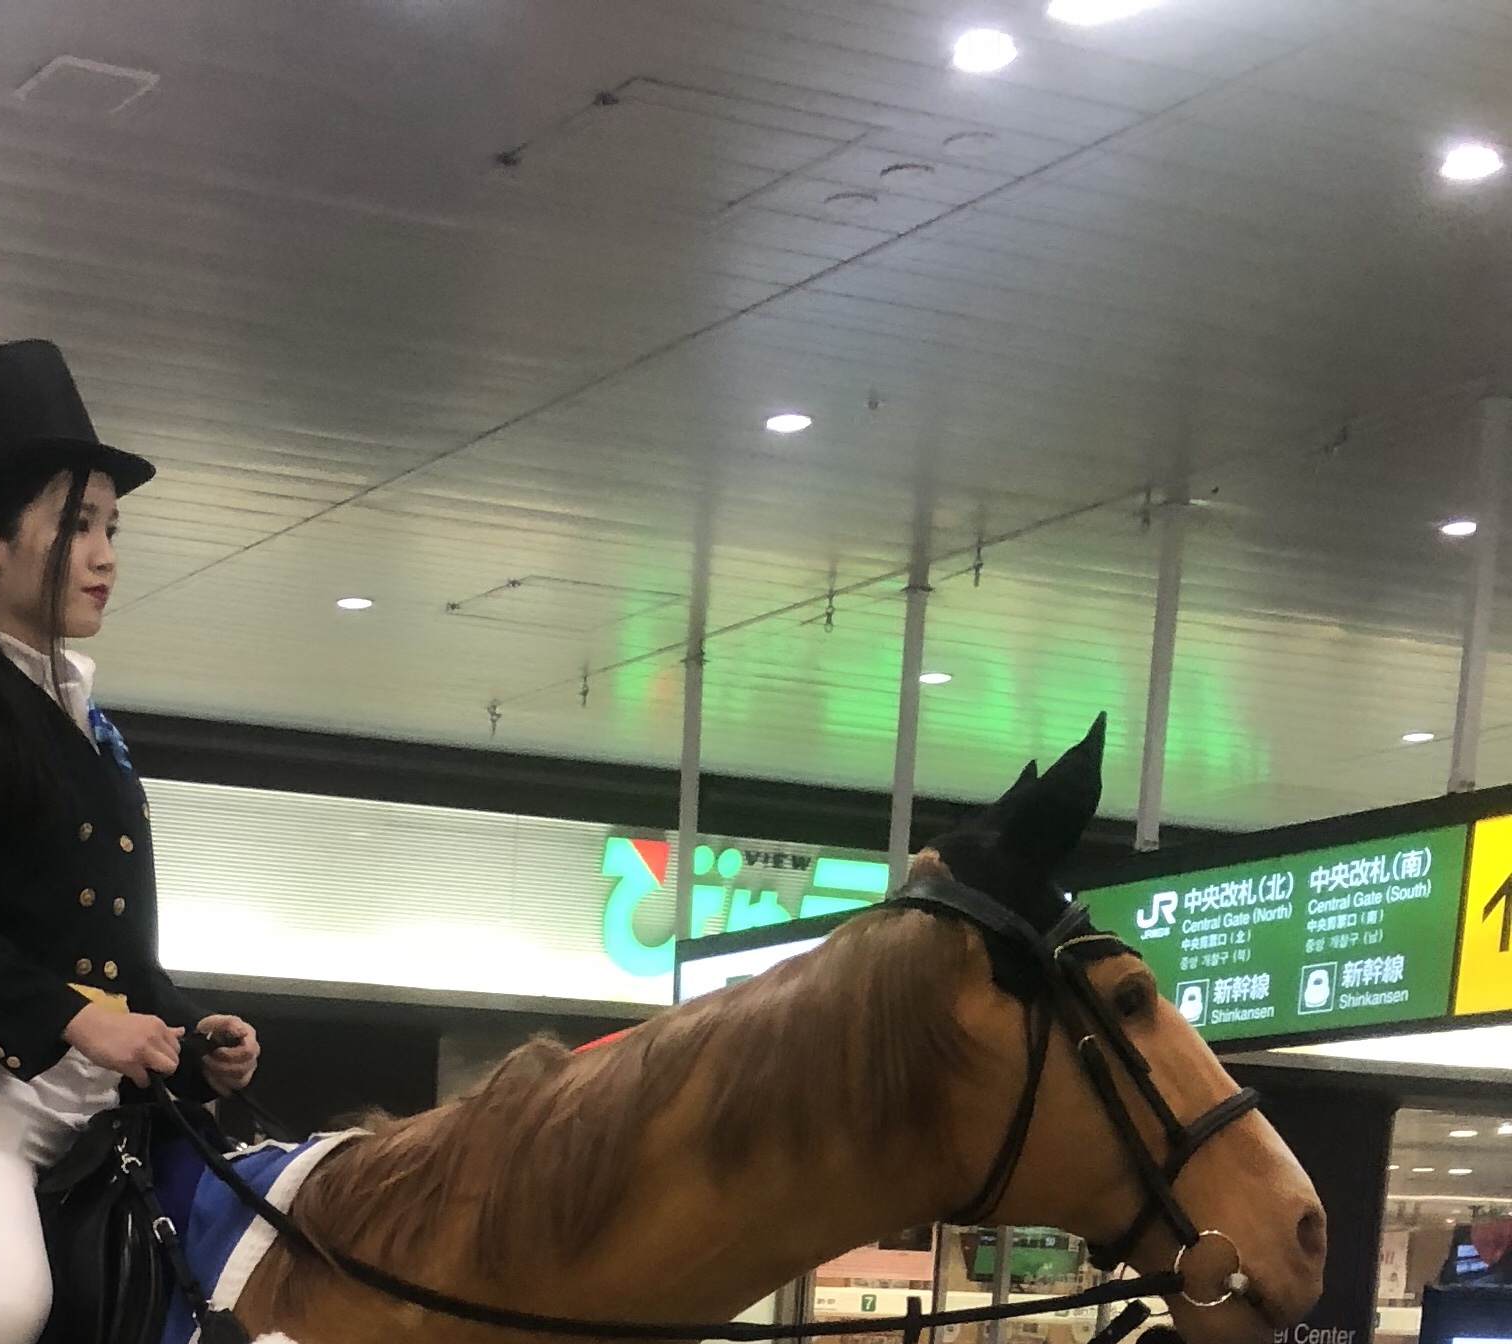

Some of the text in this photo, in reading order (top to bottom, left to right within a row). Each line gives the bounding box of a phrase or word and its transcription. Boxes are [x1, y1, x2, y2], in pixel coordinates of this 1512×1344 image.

[1309, 847, 1432, 894] 中央改札（南）
[1137, 891, 1179, 929] JR
[1184, 872, 1294, 914] 中央改札（北）
[1308, 879, 1432, 915] Central Gate (South)
[1182, 902, 1293, 934] Central Gate (North)
[1213, 972, 1271, 1005] 新幹線
[1341, 953, 1406, 989] 新幹線
[1211, 1005, 1275, 1025] Shinkansen
[1339, 989, 1409, 1009] Shinkansen
